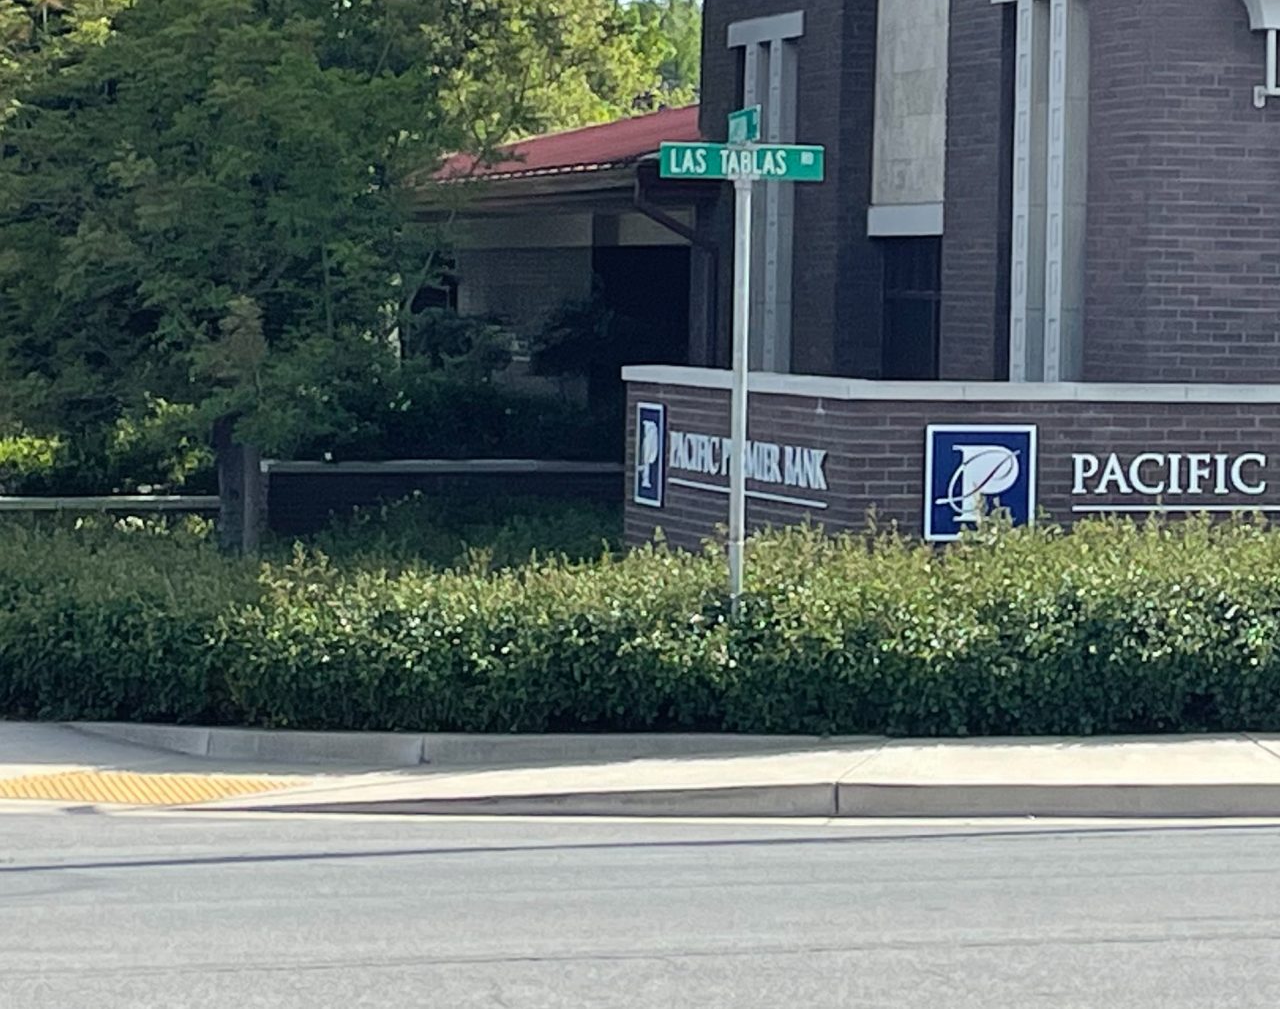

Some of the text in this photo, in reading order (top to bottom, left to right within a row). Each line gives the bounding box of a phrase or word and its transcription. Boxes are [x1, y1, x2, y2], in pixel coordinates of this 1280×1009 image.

[670, 147, 708, 174] LAS
[720, 148, 788, 176] TABLAS
[669, 430, 828, 491] PACIFIC PMIER BANK
[1071, 452, 1267, 494] PACIFIC
